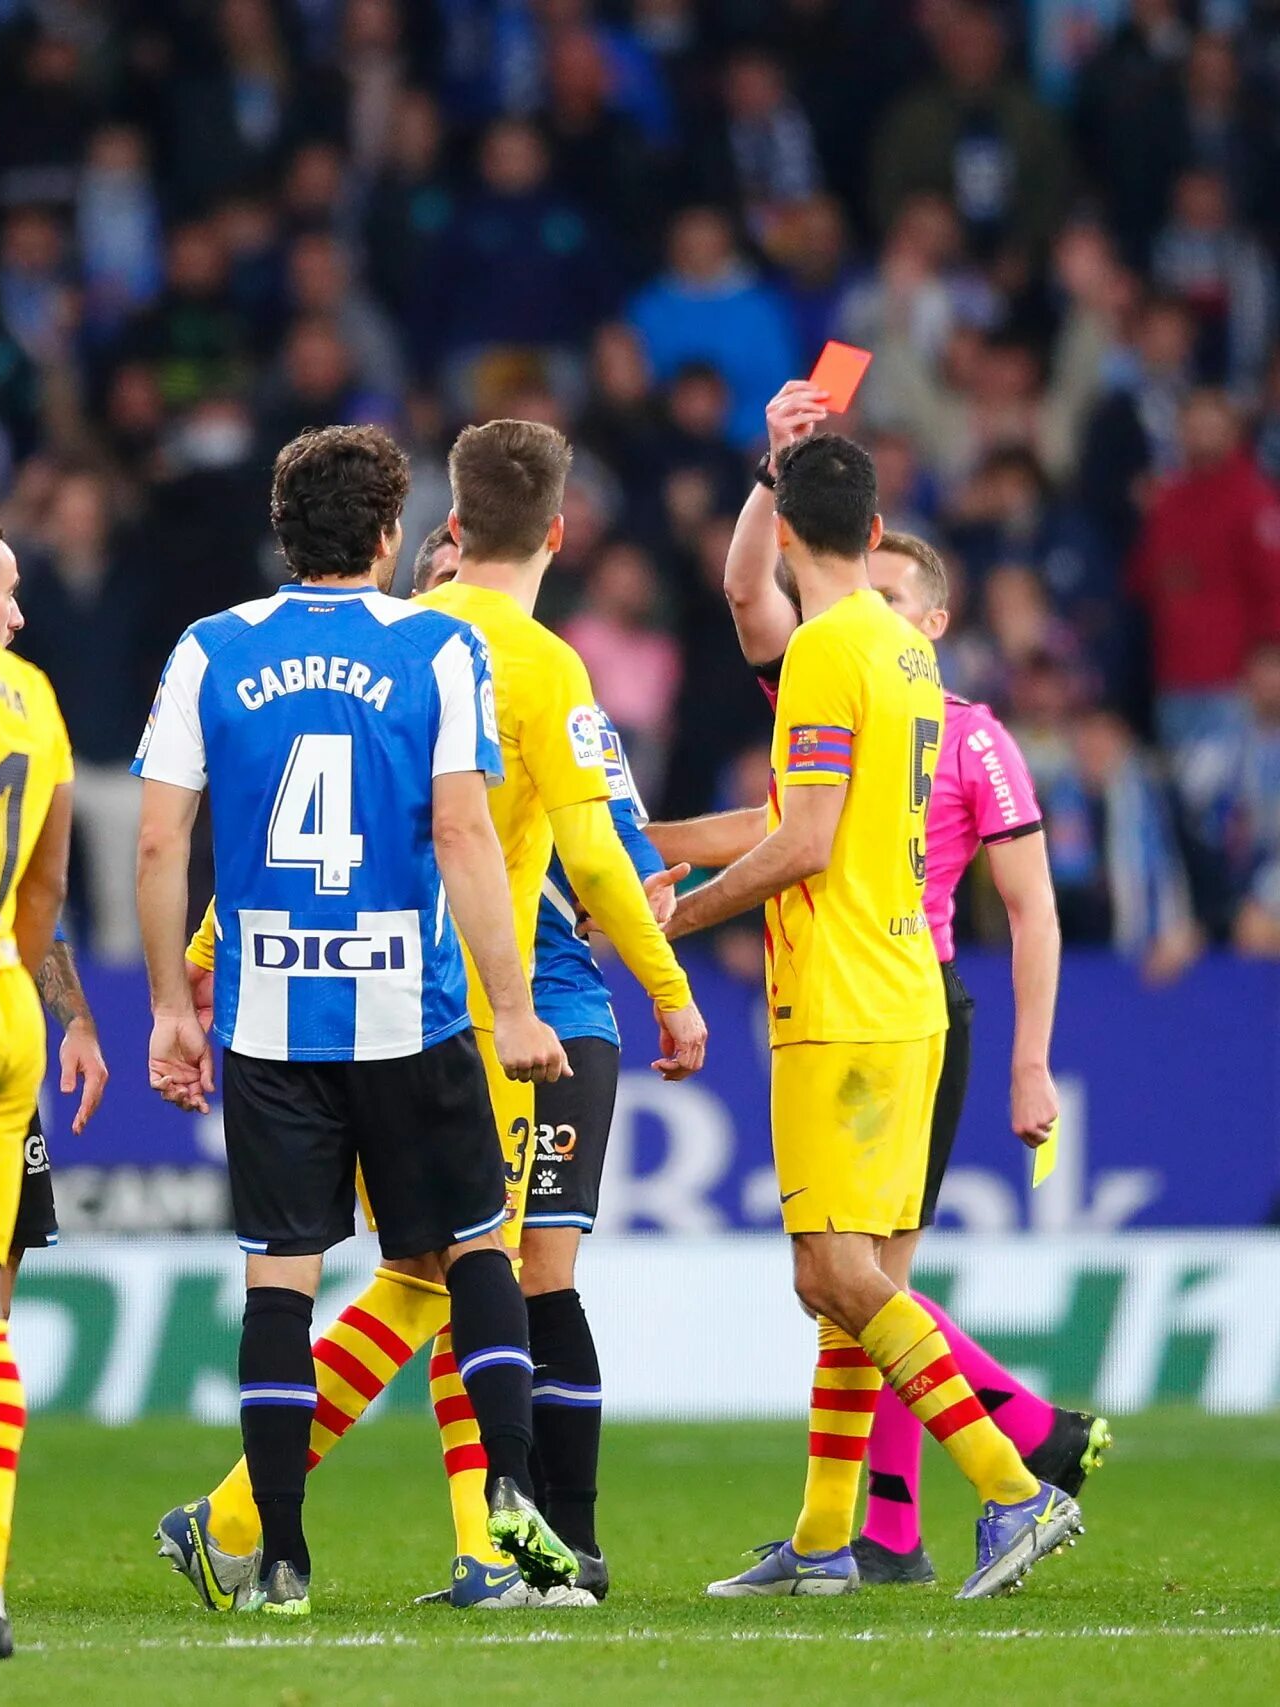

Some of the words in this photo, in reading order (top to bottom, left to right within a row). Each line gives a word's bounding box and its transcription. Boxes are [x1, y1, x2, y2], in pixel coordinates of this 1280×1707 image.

[236, 655, 394, 712] CABRERA
[981, 750, 1020, 826] WÜRTH
[265, 733, 363, 896] 4
[253, 933, 405, 970] DIGI
[504, 1116, 530, 1185] 3
[534, 1123, 577, 1154] RO
[531, 1187, 563, 1195] KELME
[899, 1374, 934, 1402] ARÇA
